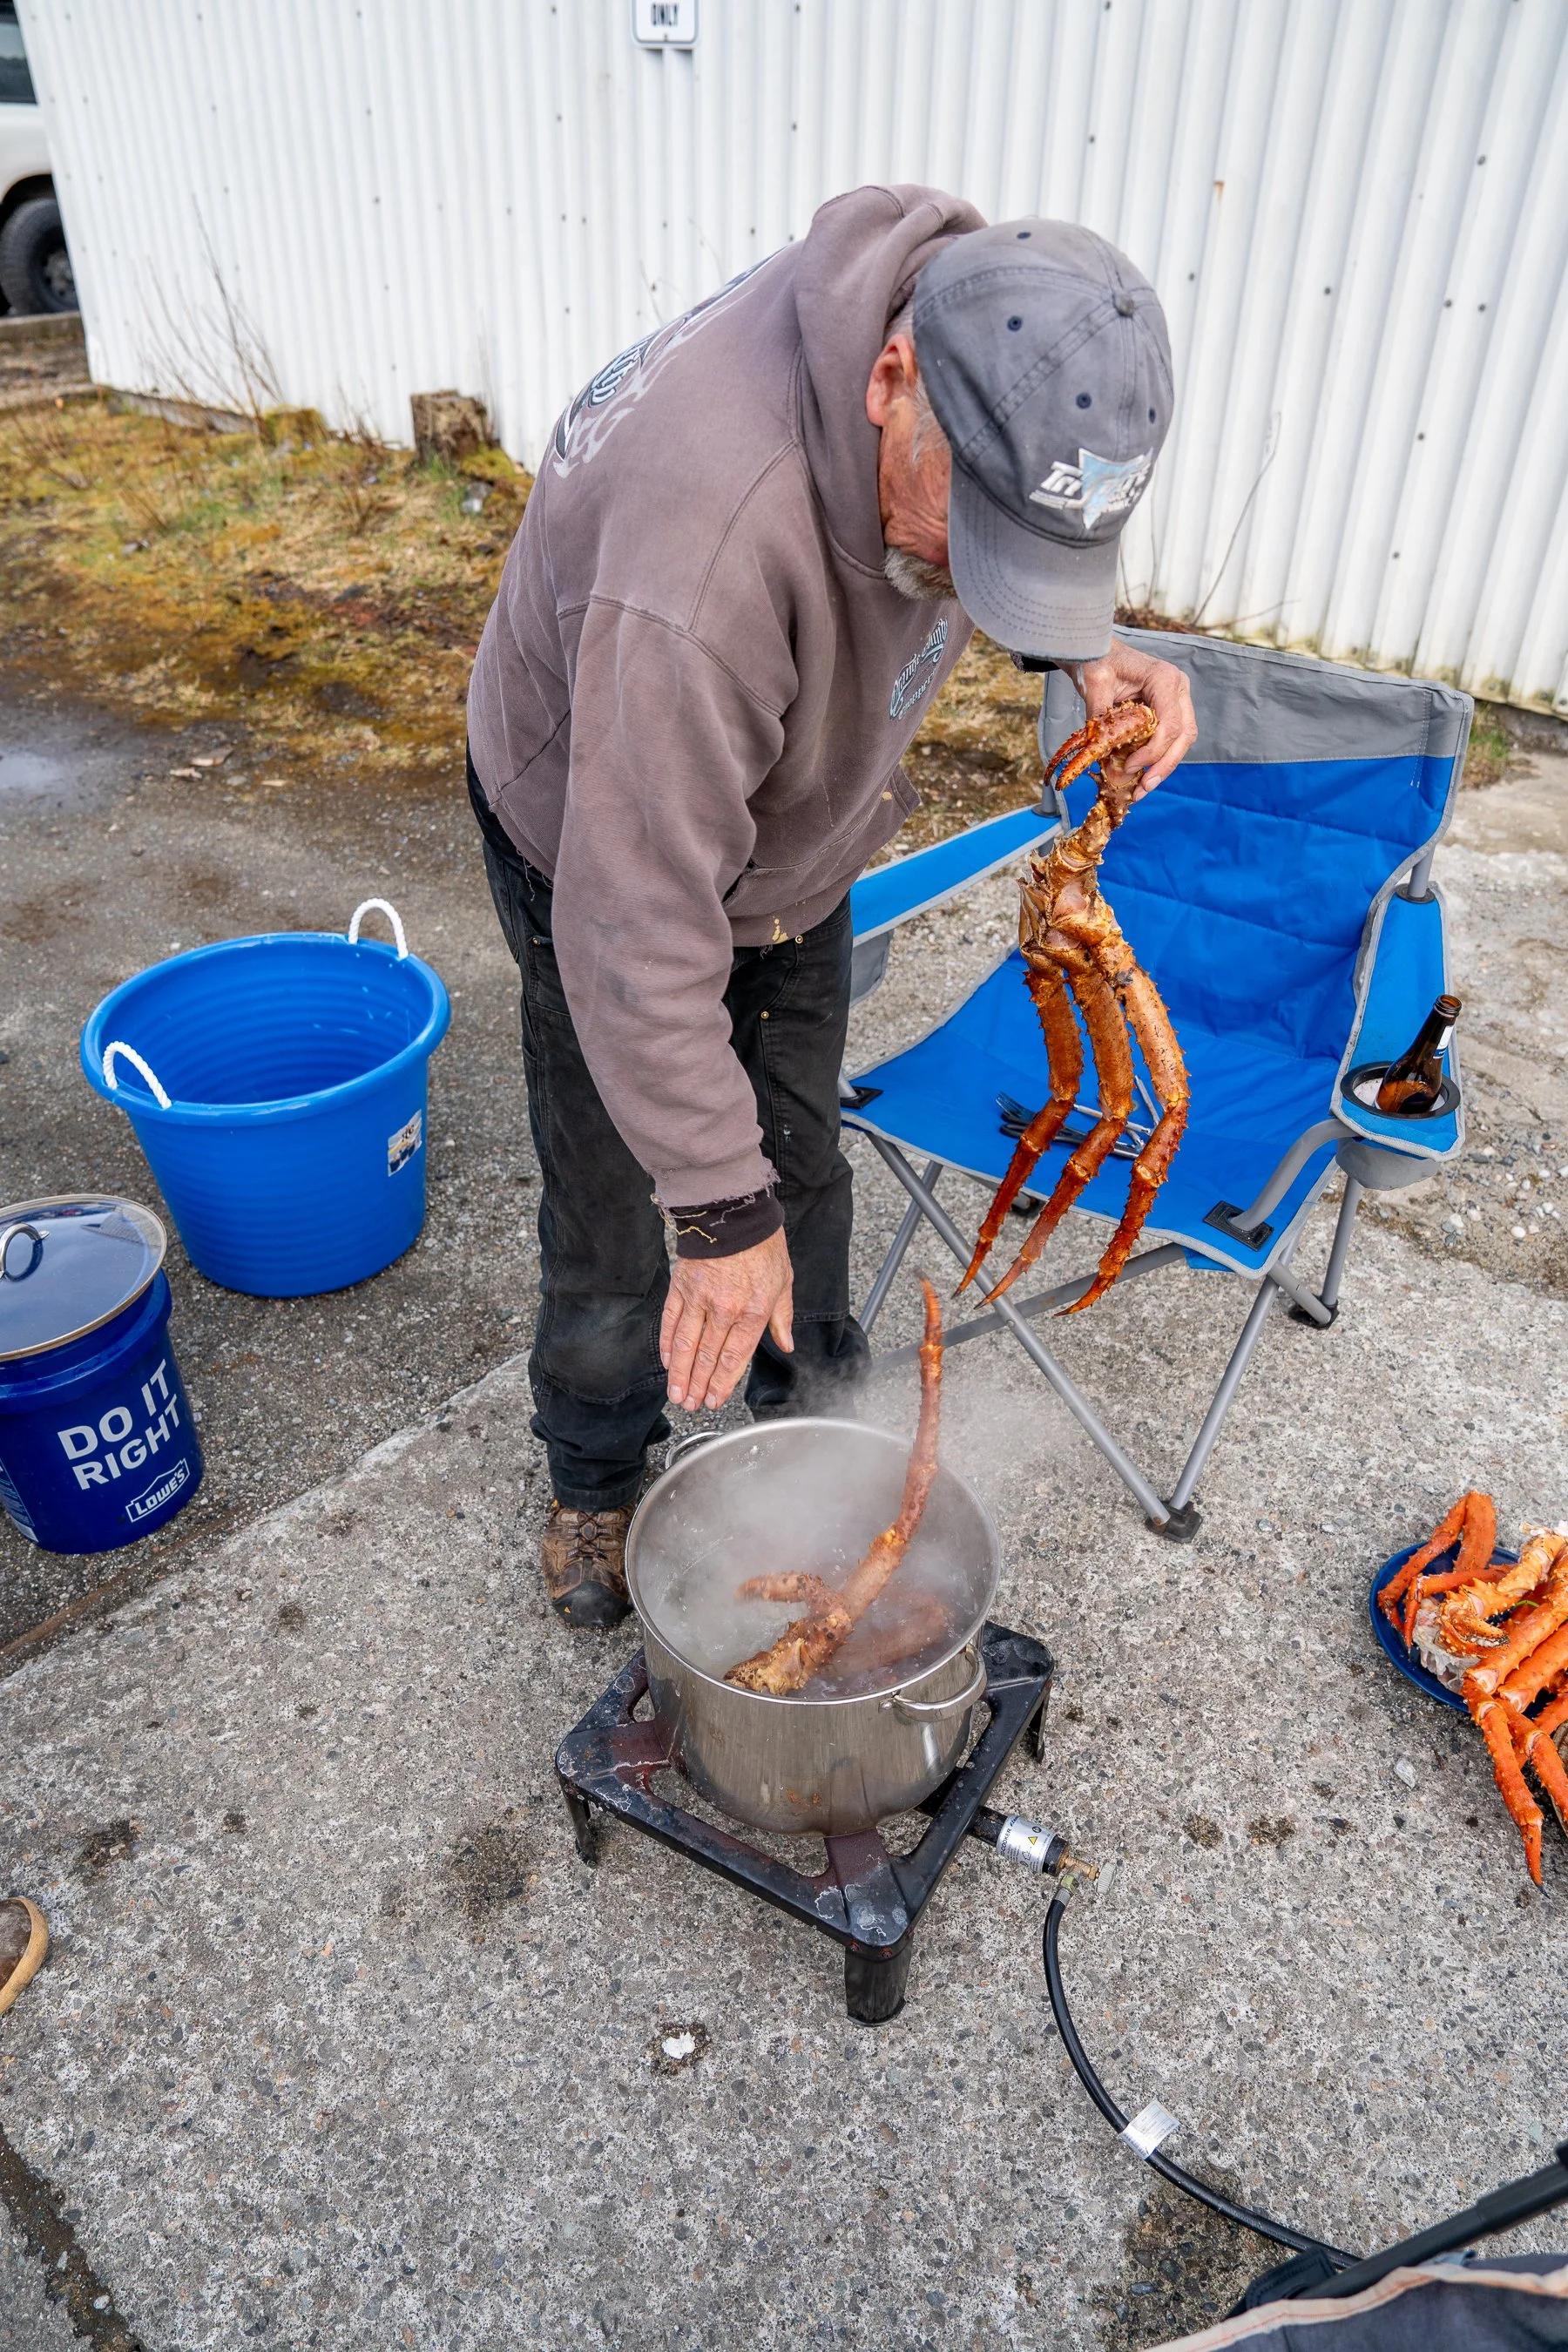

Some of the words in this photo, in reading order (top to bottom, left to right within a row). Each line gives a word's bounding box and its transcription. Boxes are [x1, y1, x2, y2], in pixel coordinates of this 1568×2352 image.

[651, 3, 678, 25] ONLY
[57, 1406, 133, 1461] DO
[141, 1359, 169, 1416] IT
[72, 1393, 180, 1490] RIGHT
[134, 1467, 186, 1516] LOWE'S
